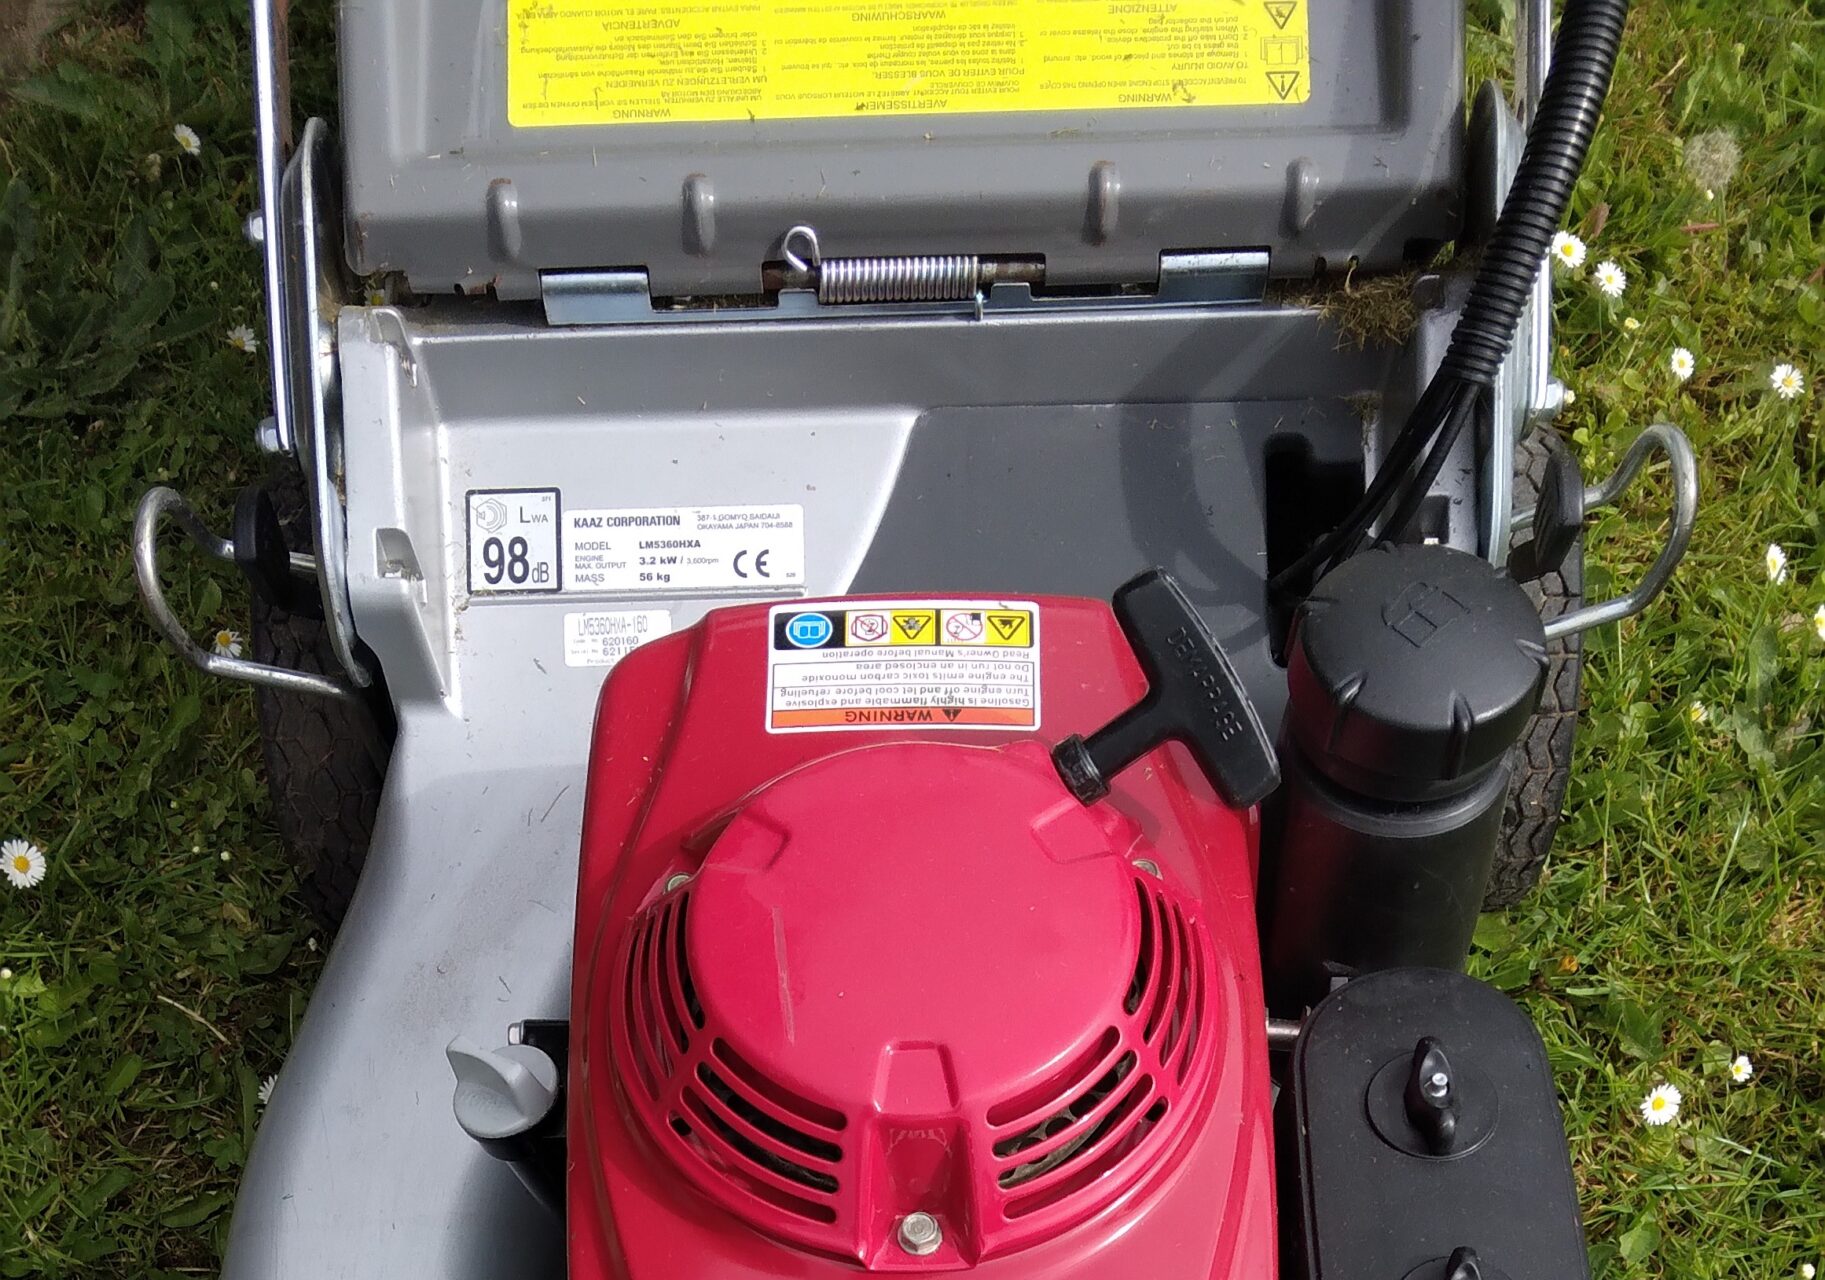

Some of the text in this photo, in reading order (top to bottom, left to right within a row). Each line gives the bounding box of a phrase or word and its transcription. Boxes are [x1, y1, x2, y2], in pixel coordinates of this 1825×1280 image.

[1108, 4, 1177, 14] ATTENZIONE
[851, 10, 946, 22] WAARSCHUWING
[998, 67, 1025, 76] POUR
[1171, 61, 1248, 71] TO AVOID INJURY
[919, 69, 946, 78] VOUS
[947, 69, 961, 77] DE
[606, 75, 768, 88] UM VERLETZUNGEN ZU VERMEIDEN
[1118, 93, 1172, 103] WARNING
[612, 108, 671, 119] WARNUNG
[574, 515, 681, 529] KAAZ CORPORATION
[735, 522, 759, 530] JAPAN
[575, 540, 701, 551] MODEL LM5360HXA
[483, 536, 550, 585] 98 dB
[575, 554, 604, 562] ENGINE
[639, 556, 656, 566] 3.2
[660, 556, 677, 565] kW
[733, 549, 770, 579] CE
[575, 572, 671, 583] MASS 56 kg
[578, 615, 648, 636] LM5360HXA-160
[602, 636, 639, 647] 620160
[822, 648, 1029, 659] Read Owner's Manual before operation
[855, 662, 1029, 672] Do not run in an enclosed area
[801, 671, 1029, 683] The engine emits toxic carbon monoxide
[780, 684, 1030, 698] Turn engine off and let cool before refueling
[785, 695, 1030, 708] Gasoline is highly flammable and explosive
[844, 709, 933, 723] WARNING
